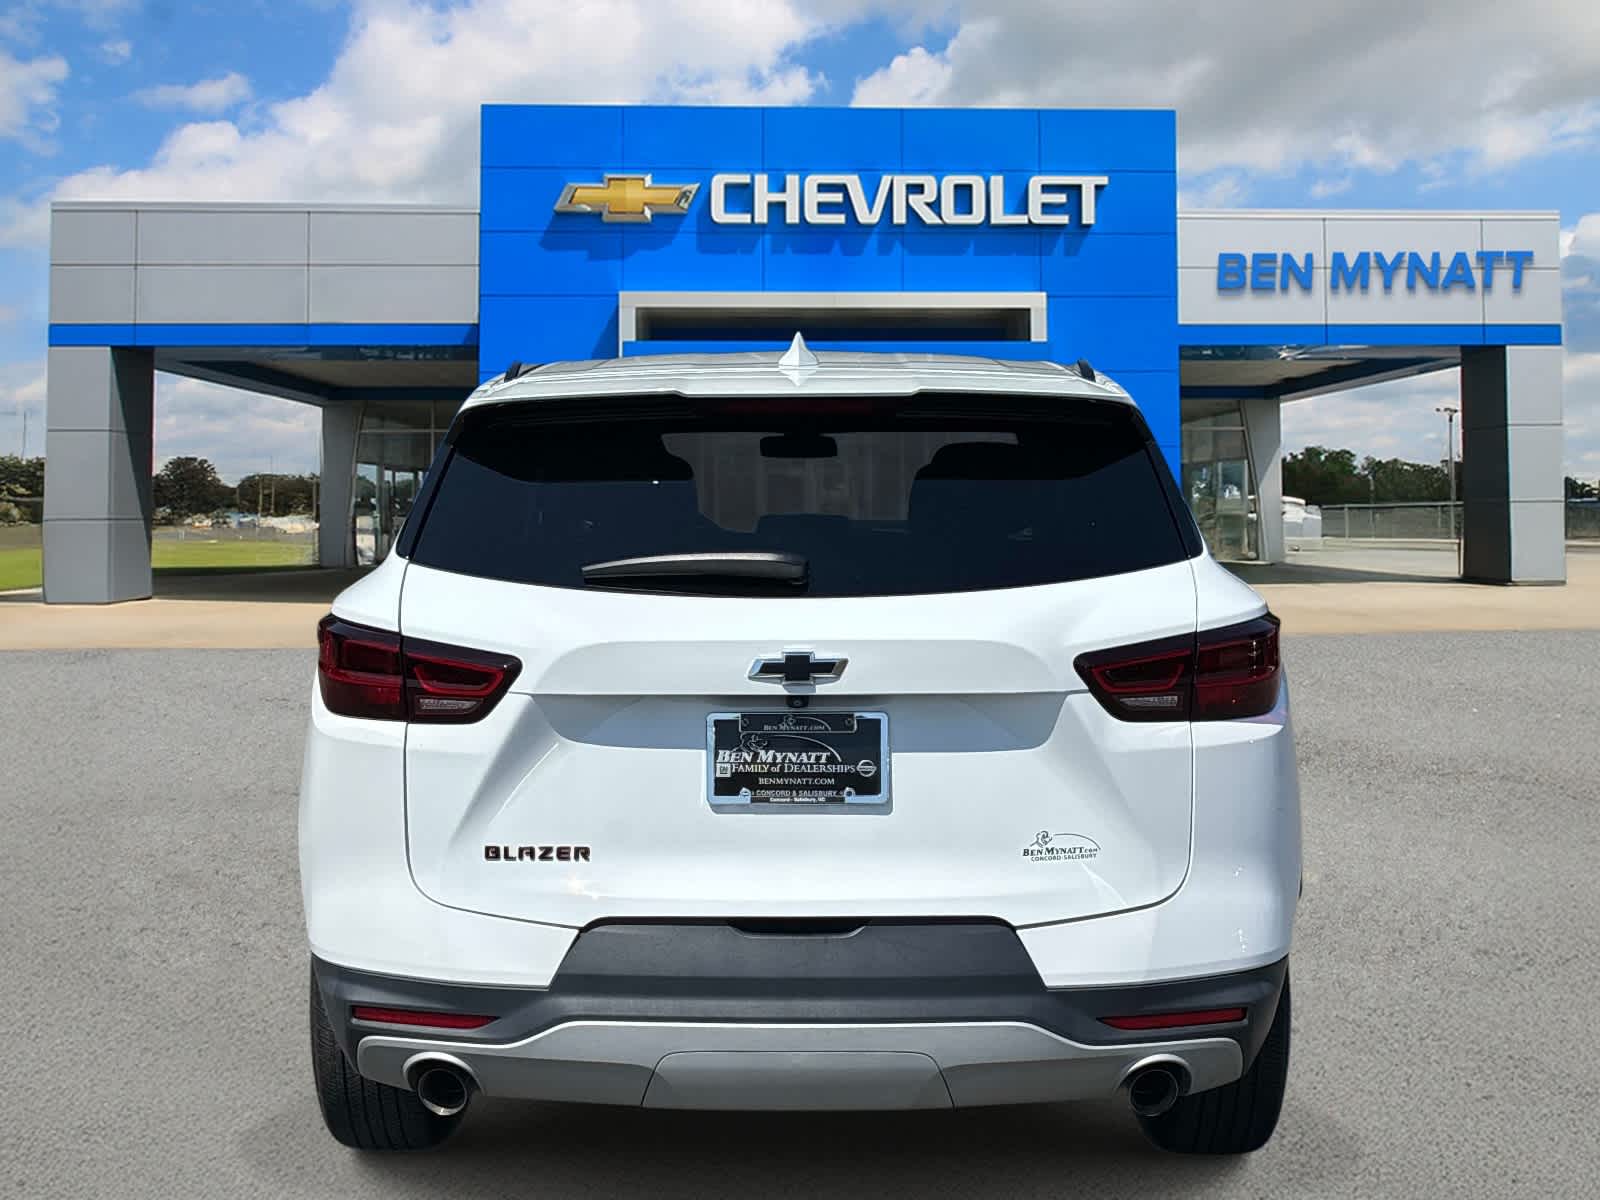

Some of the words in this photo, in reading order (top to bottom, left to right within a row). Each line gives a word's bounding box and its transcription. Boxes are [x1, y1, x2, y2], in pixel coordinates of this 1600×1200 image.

[711, 173, 1109, 225] CHEVROLET
[1217, 252, 1313, 290] BEN
[1330, 250, 1534, 289] MYNATT
[716, 750, 752, 763] BEN
[756, 750, 831, 763] MYNATT
[732, 763, 769, 773] FAMILY
[771, 764, 780, 773] of
[784, 763, 856, 773] DEALERSHIPS
[758, 777, 835, 785] BENMYNATT.COM
[756, 790, 791, 798] CONCORD
[799, 790, 837, 798] SALISBURY
[484, 846, 591, 861] BLAZER
[1023, 848, 1043, 856] BEN
